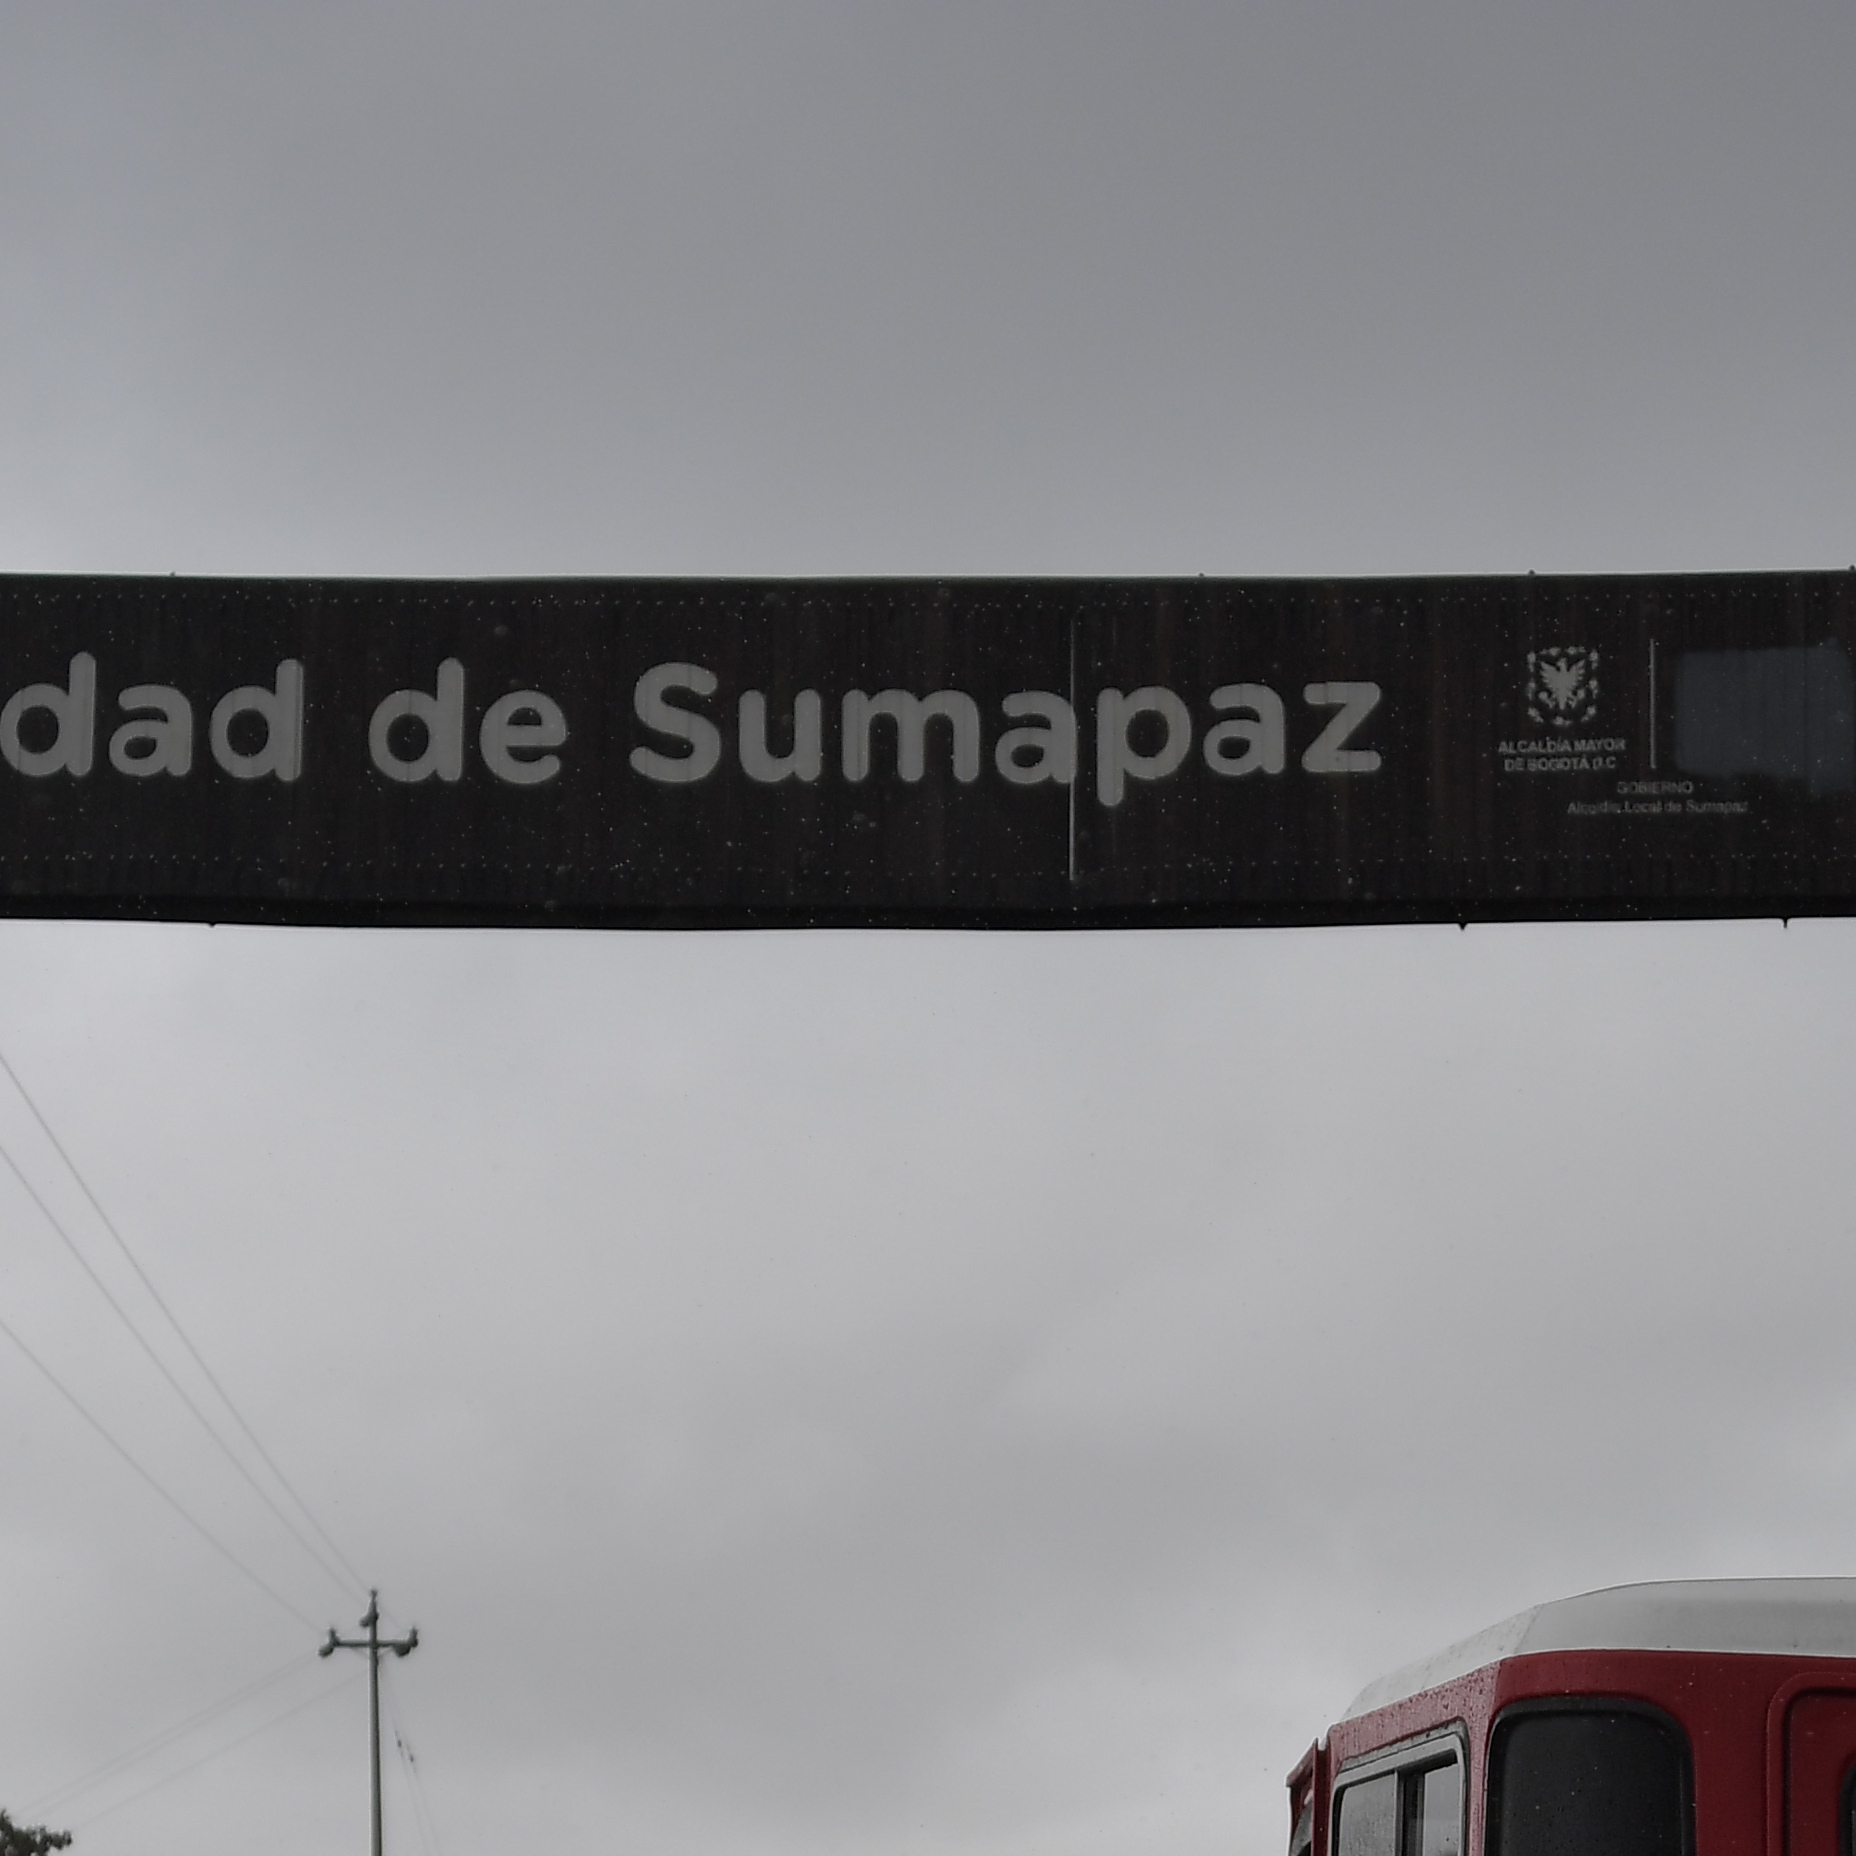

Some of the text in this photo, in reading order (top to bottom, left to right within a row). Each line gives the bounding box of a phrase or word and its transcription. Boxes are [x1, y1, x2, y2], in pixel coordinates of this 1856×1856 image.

[367, 656, 568, 784] de
[629, 661, 1383, 807] Sumapaz
[1574, 738, 1626, 752] MAYOR
[1504, 757, 1524, 771] DE
[1617, 780, 1694, 794] GOBIERNO
